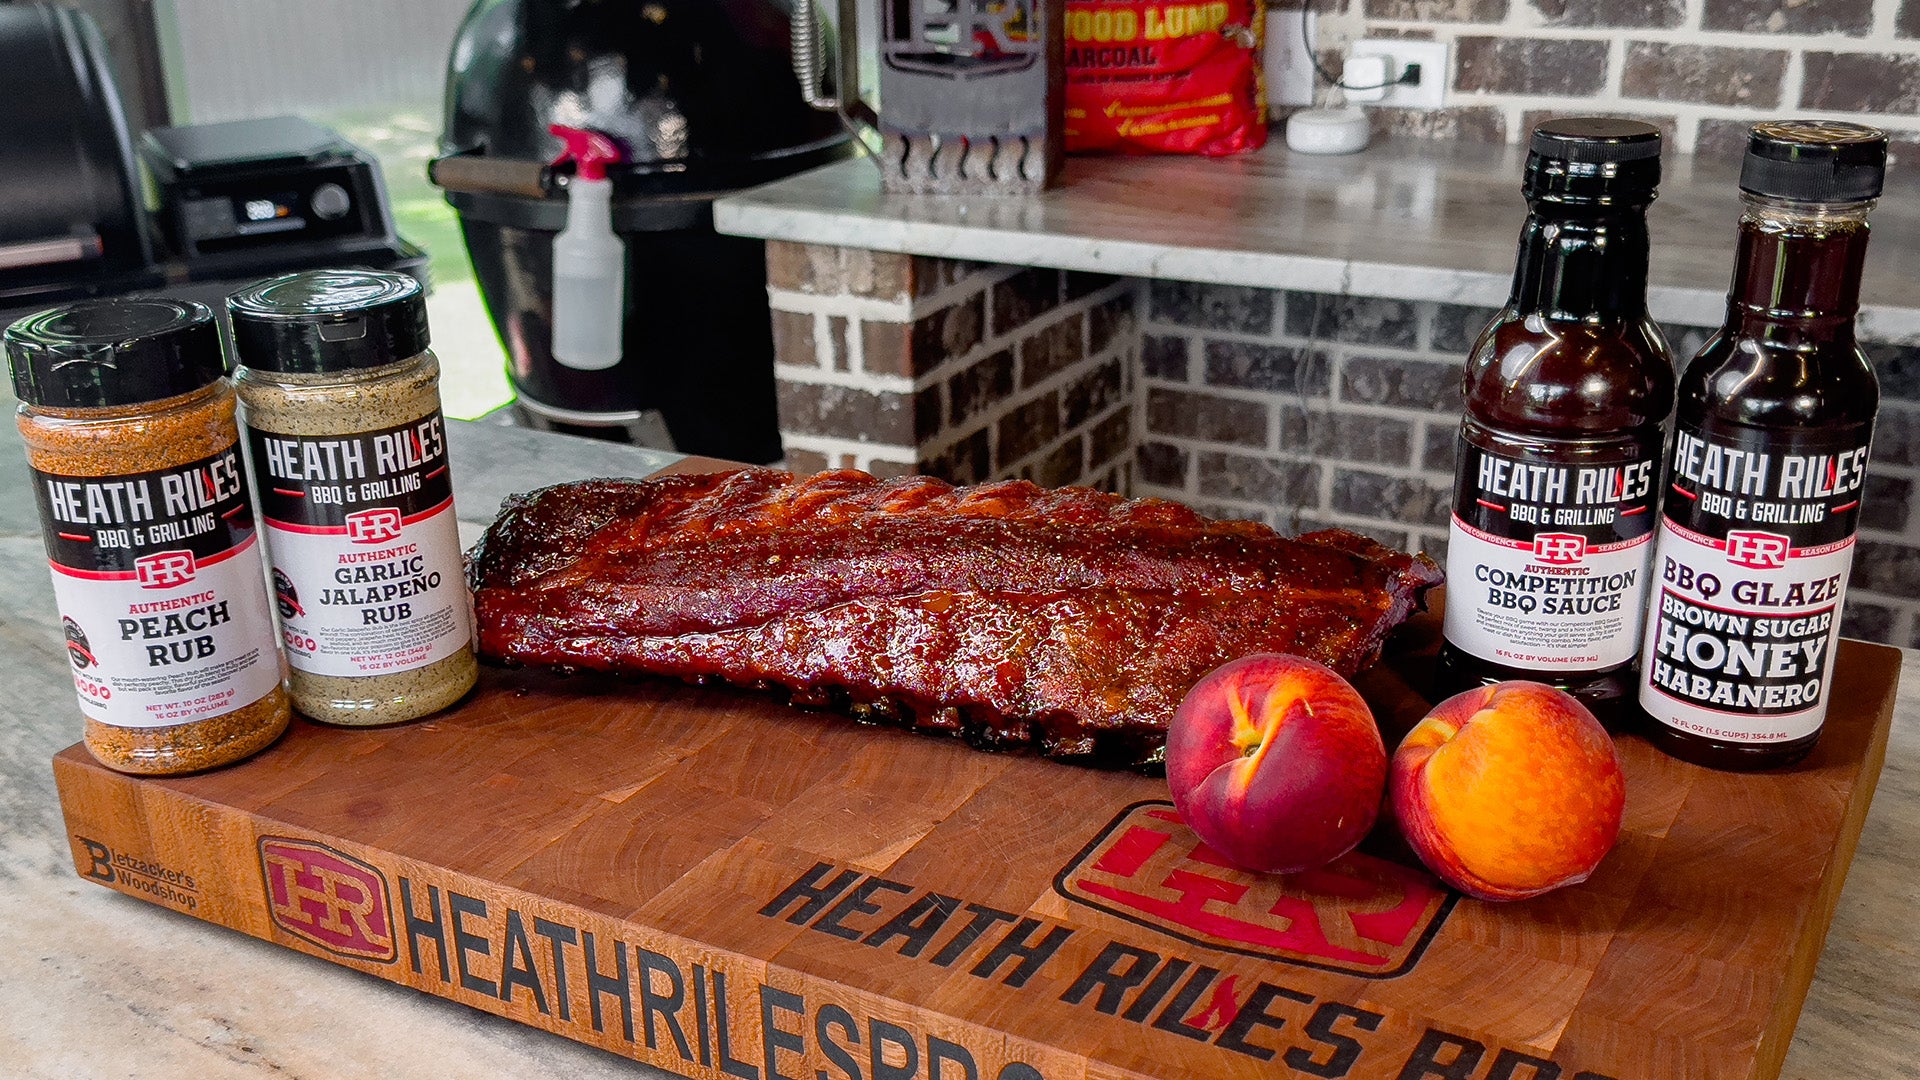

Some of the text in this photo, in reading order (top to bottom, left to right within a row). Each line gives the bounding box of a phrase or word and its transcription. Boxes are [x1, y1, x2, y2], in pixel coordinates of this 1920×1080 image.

[1144, 2, 1229, 40] LUMP
[264, 416, 443, 481] HEATH RILES
[1674, 430, 1867, 499] HEATH RILES
[47, 453, 241, 524] HEATH RILES
[311, 472, 421, 506] BBQ & GRILLING
[1478, 454, 1652, 504] HEATH RILES
[1510, 503, 1616, 526] BBQ & GRILLING
[1701, 491, 1826, 524] BBQ & GRILLING
[97, 512, 216, 549] BBQ & GRILLING
[349, 512, 402, 540] HR
[338, 543, 418, 564] AUTHENTIC
[1535, 537, 1586, 562] HR
[1597, 541, 1628, 553] SEASON
[1728, 534, 1788, 566] HR
[1800, 545, 1831, 556] SEASON
[137, 557, 194, 587] HR
[334, 555, 424, 585] GARLIC
[1475, 564, 1637, 596] COMPETITION
[1524, 564, 1591, 576] AUTHENTIC
[1663, 555, 1841, 607] BBQ GLAZE
[129, 590, 215, 615] AUTHENTIC
[319, 571, 442, 606] JALAPEÑO
[1487, 587, 1622, 616] BBQ SAUCE
[118, 600, 231, 641] PEACH
[361, 602, 413, 626] RUB
[1662, 593, 1831, 638] BROWN SUGAR
[146, 634, 217, 667] RUB
[395, 650, 406, 658] OZ
[395, 653, 427, 666] VOLUME
[1537, 655, 1569, 663] VOLUME
[1570, 656, 1585, 664] (473
[1657, 617, 1828, 678] HONEY
[1653, 658, 1821, 709] HABANERO
[146, 704, 163, 713] NET
[164, 702, 181, 711] WT.
[193, 697, 207, 705] OZ
[166, 711, 179, 719] OZ
[181, 708, 192, 717] BY
[194, 699, 230, 714] VOLUME
[1672, 716, 1679, 725] 12
[1680, 720, 1690, 729] FL
[1691, 724, 1704, 733] OZ
[1705, 727, 1720, 736] (1.5
[1721, 730, 1749, 740] CUPS)
[116, 868, 197, 909] Woodshop
[266, 852, 391, 946] HR
[757, 861, 1387, 1080] HEATH RILES
